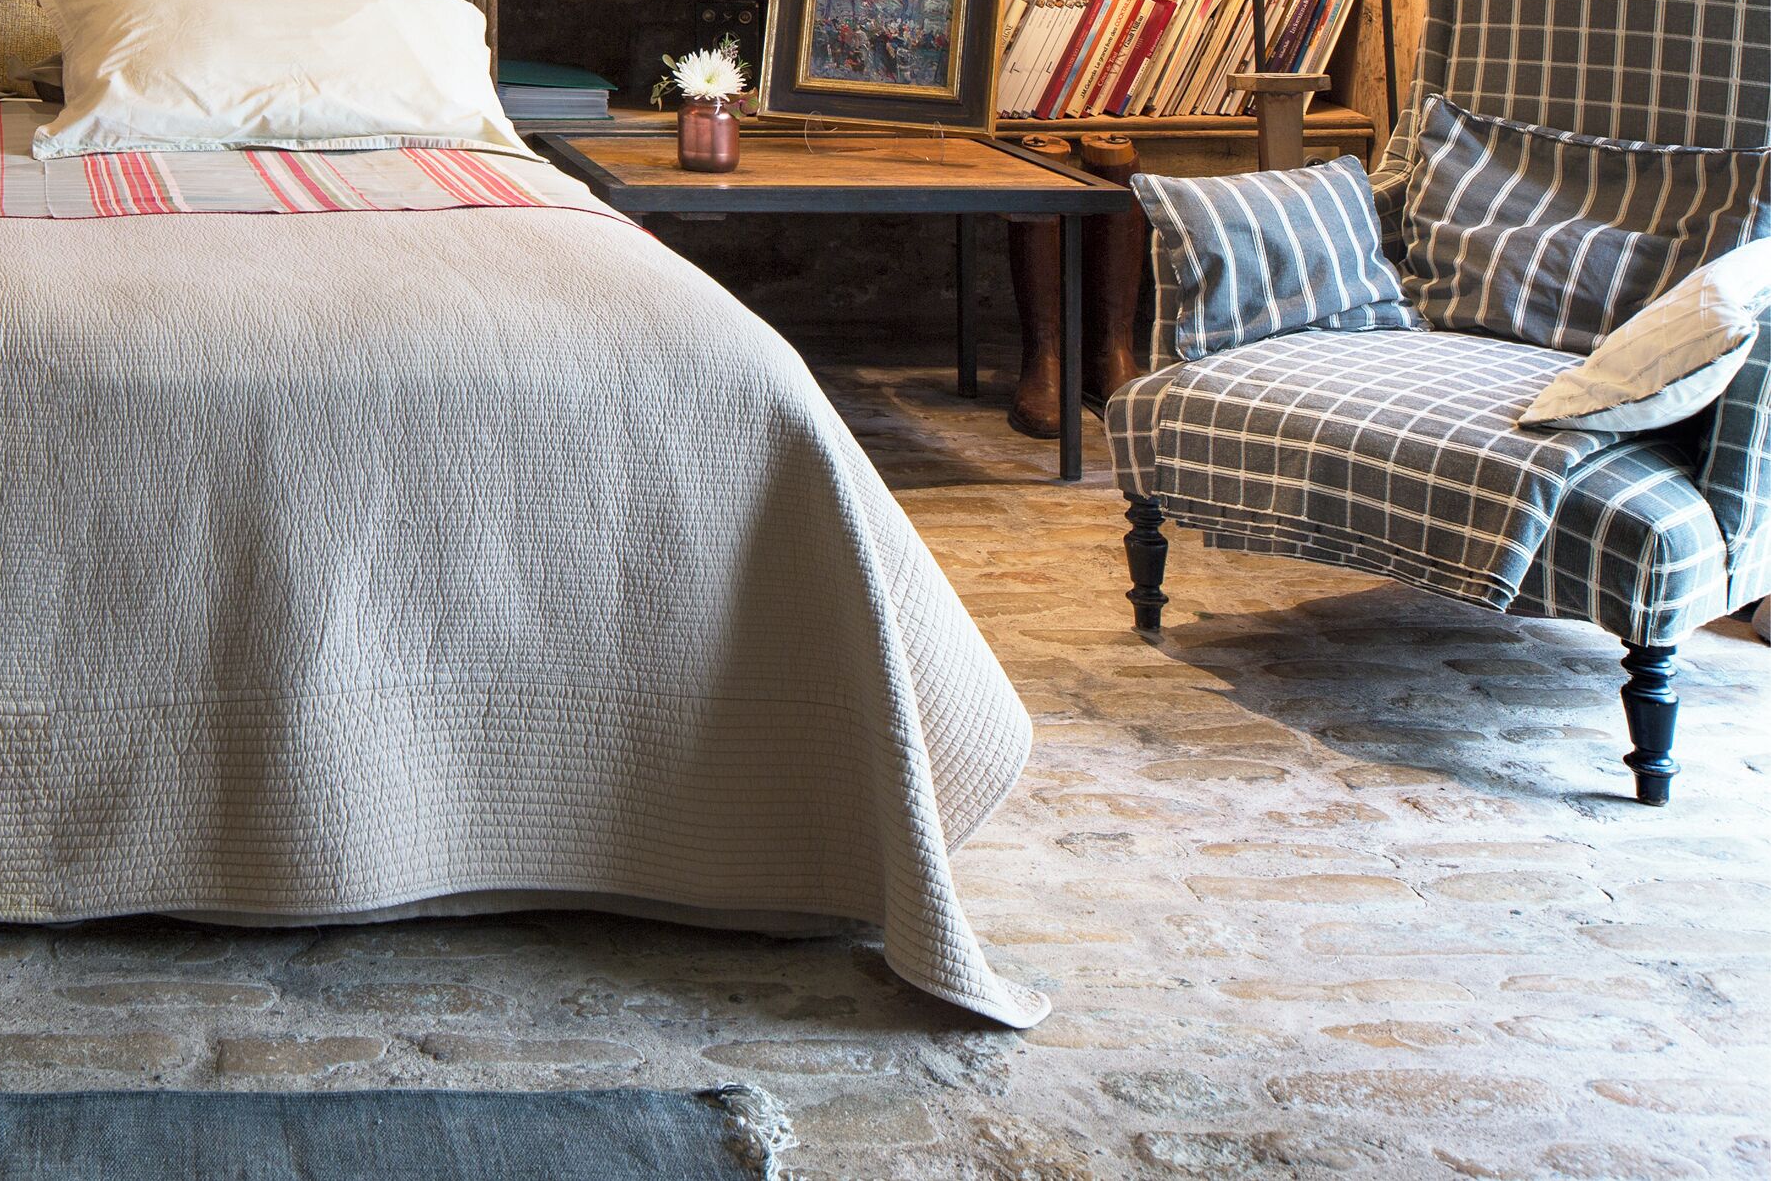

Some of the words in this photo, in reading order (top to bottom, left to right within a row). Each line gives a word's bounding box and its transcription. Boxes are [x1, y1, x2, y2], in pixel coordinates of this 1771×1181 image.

[1109, 26, 1118, 37] des
[1104, 35, 1114, 47] livre
[1097, 46, 1109, 62] grand
[1093, 60, 1102, 69] Le
[1097, 72, 1108, 88] Côtes
[1104, 64, 1112, 73] de
[1108, 50, 1119, 64] Toul
[1109, 50, 1127, 76] VIN
